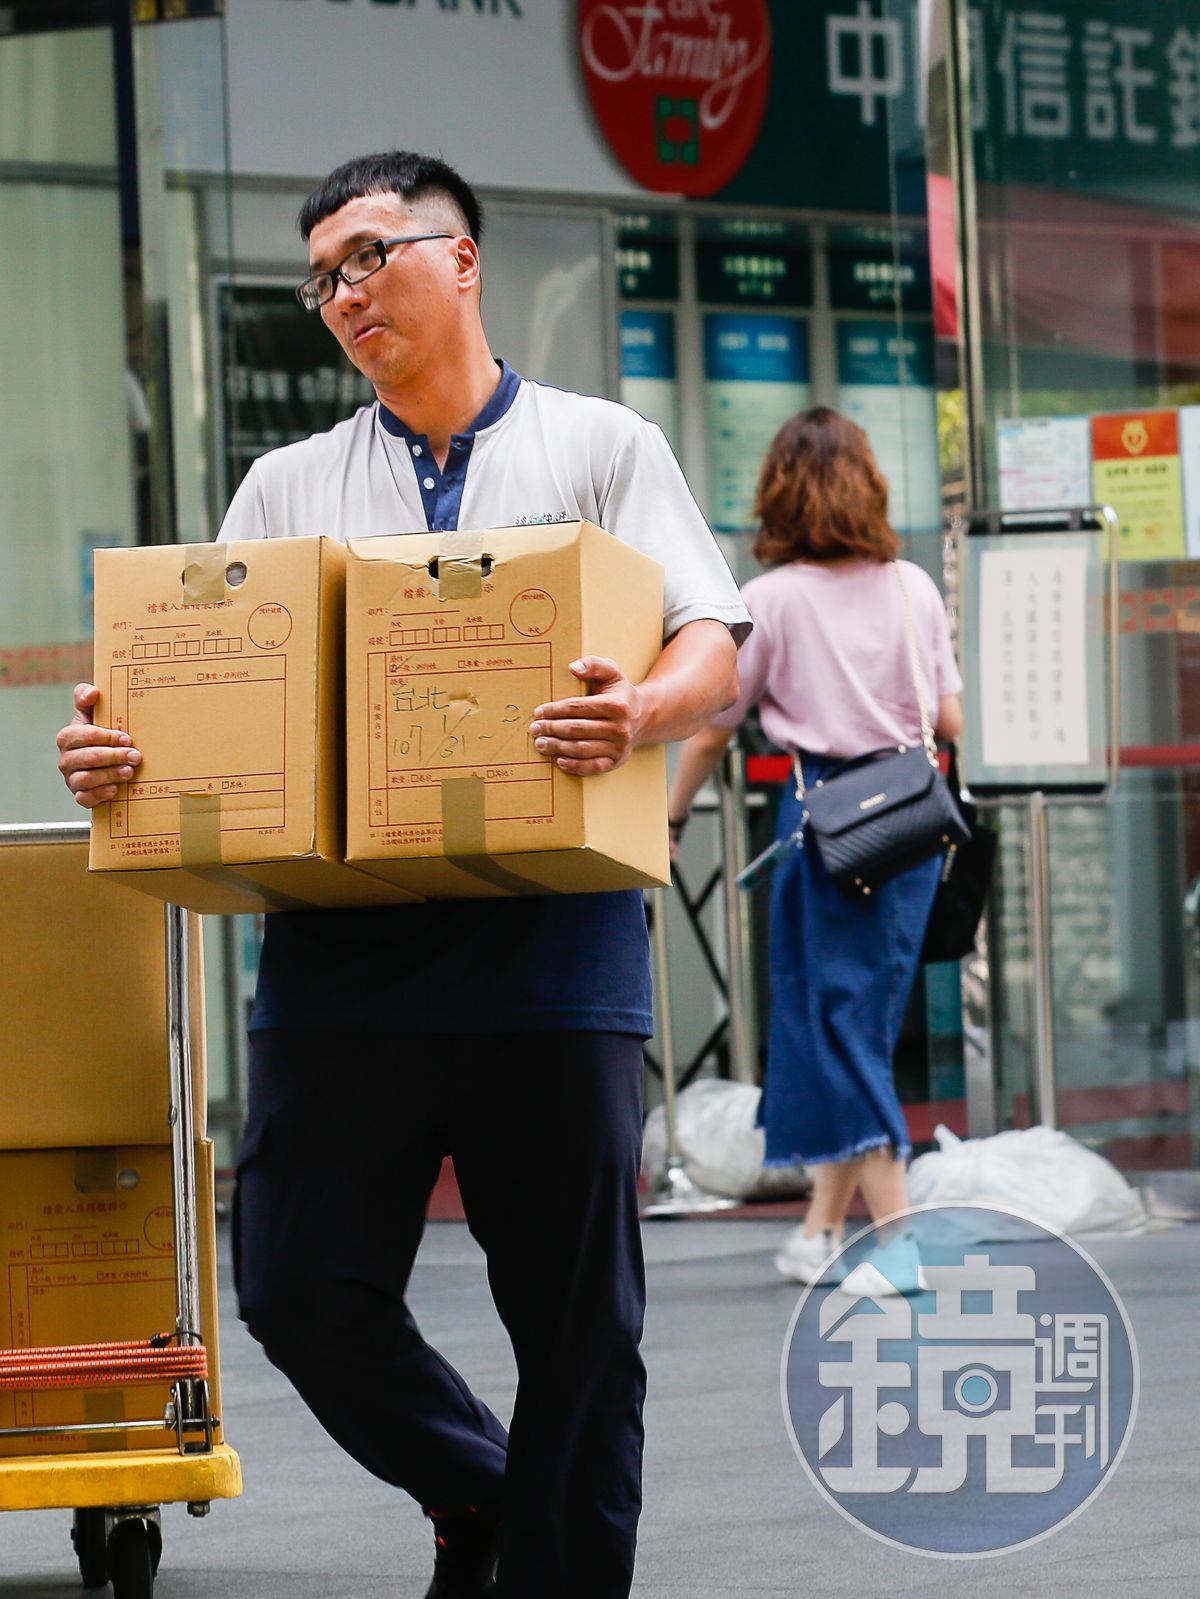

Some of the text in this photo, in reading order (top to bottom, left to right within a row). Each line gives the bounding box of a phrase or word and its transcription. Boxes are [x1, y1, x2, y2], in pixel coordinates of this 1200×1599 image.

[582, 0, 771, 129] Family
[826, 2, 1200, 146] 中信託
[392, 684, 450, 712] 台北
[392, 725, 423, 766] 107
